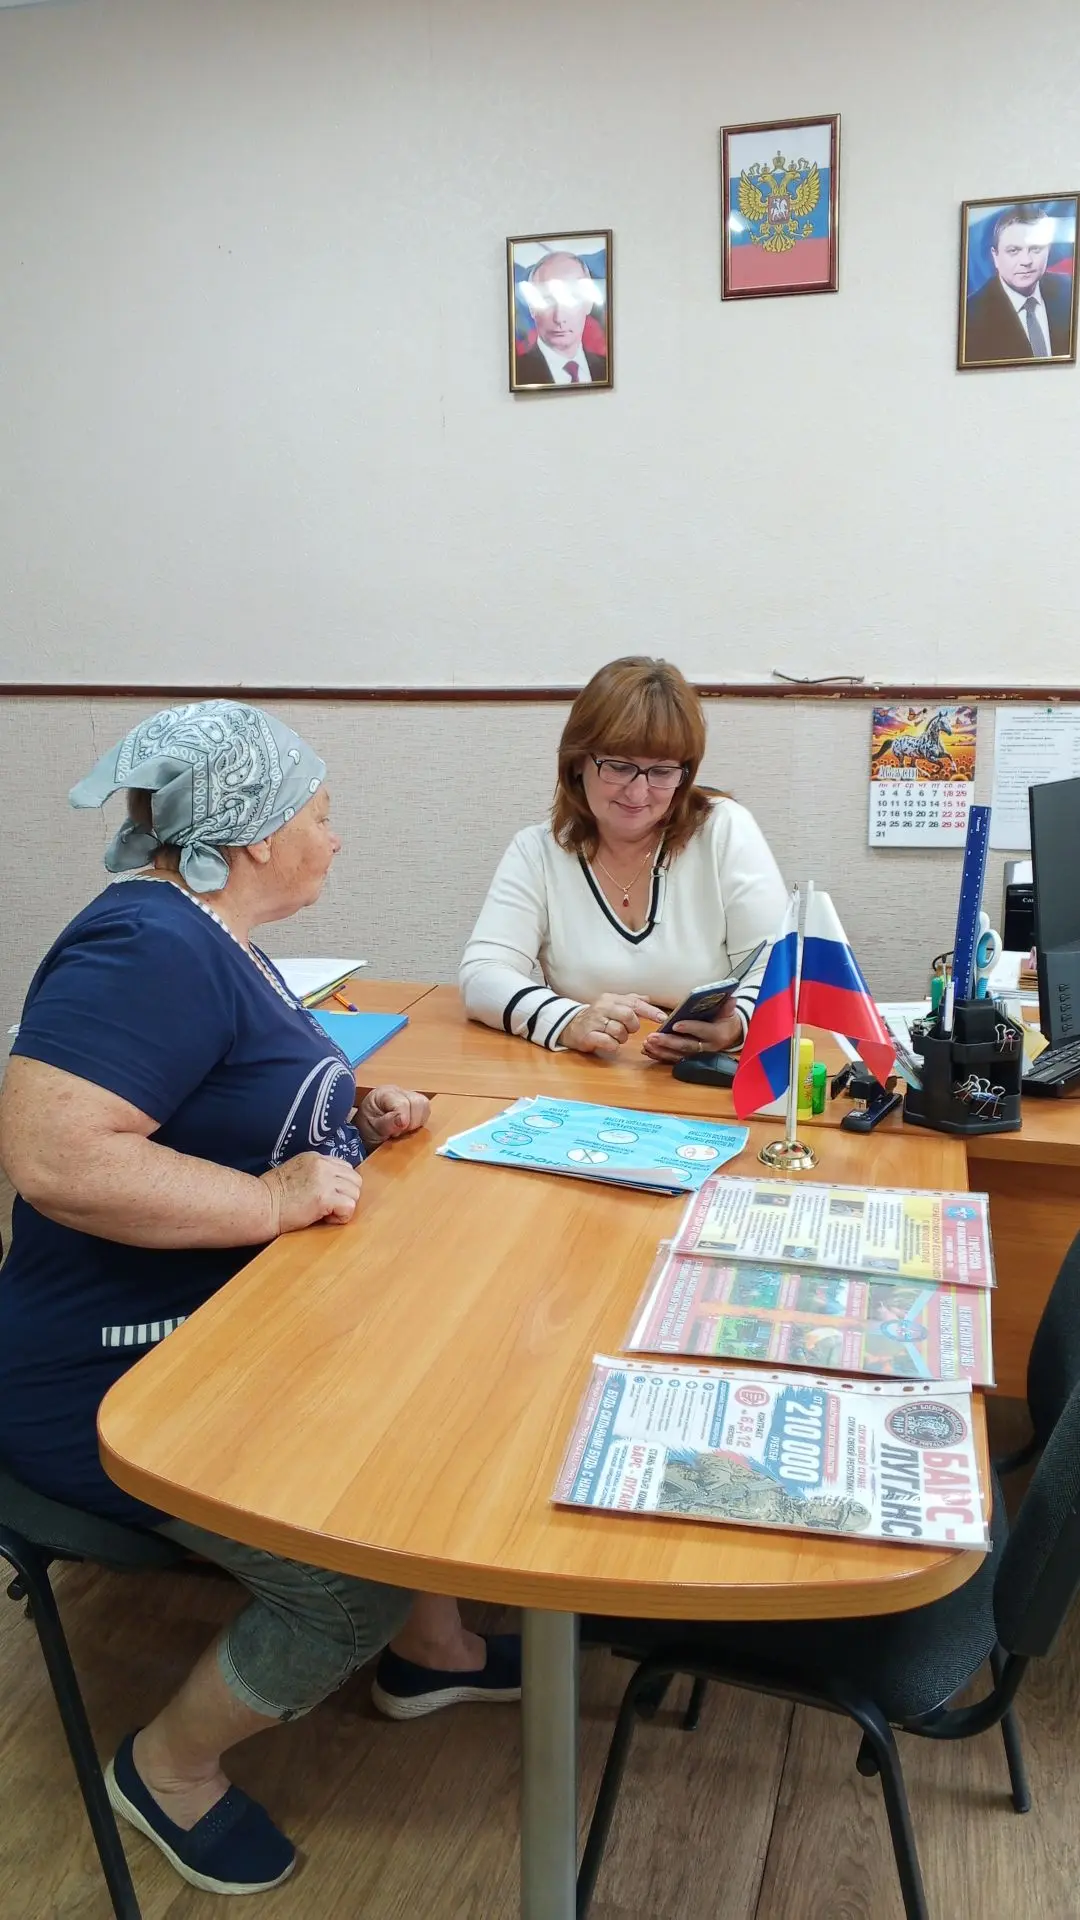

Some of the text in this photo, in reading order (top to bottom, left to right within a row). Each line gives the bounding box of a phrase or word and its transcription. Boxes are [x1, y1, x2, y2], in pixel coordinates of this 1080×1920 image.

[603, 1389, 619, 1408] БУДЬ
[590, 1409, 612, 1449] СИЛЬНЫМ!
[754, 1412, 766, 1439] КОНТРАКТ
[846, 1416, 855, 1437] СЛУЖИ
[893, 1415, 904, 1433] ЛНР
[768, 1435, 780, 1461] РУБЛЕЙ
[779, 1395, 823, 1482] ОТ 210 000
[846, 1438, 857, 1457] СВОЕЙ
[585, 1449, 601, 1470] БУДЬ
[629, 1445, 645, 1469] БАРС
[647, 1448, 658, 1466] СТАНЬ
[641, 1467, 653, 1489] ЧАСТЬЮ
[881, 1443, 922, 1536] ЛУГАНС
[922, 1452, 974, 1524] БАРС
[573, 1478, 592, 1503] НАМИ!
